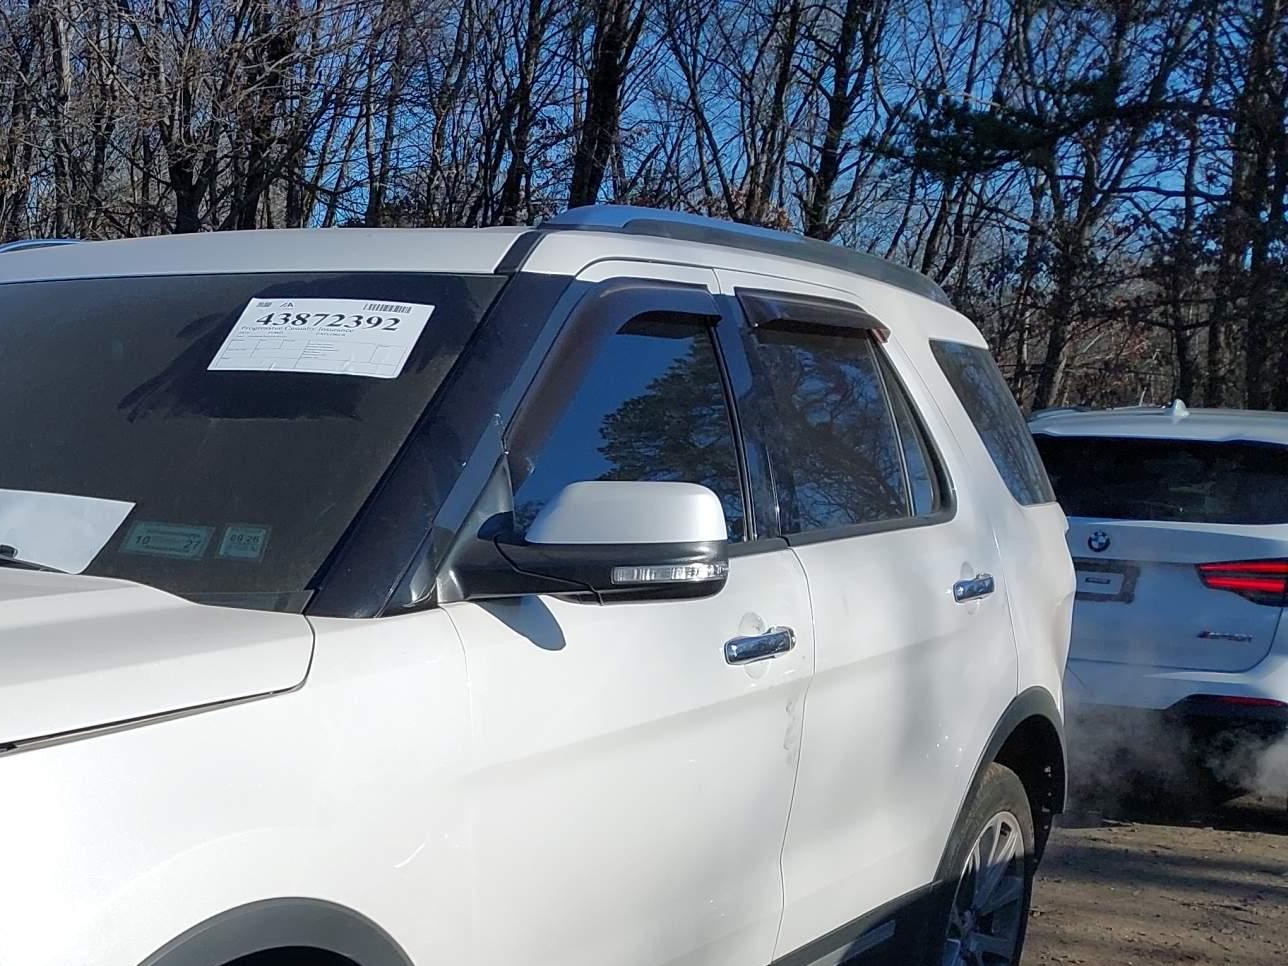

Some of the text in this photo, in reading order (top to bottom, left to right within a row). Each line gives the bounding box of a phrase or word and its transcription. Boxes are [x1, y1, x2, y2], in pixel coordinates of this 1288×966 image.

[256, 312, 401, 331] 43872392
[136, 535, 152, 545] 10
[183, 543, 199, 553] 27
